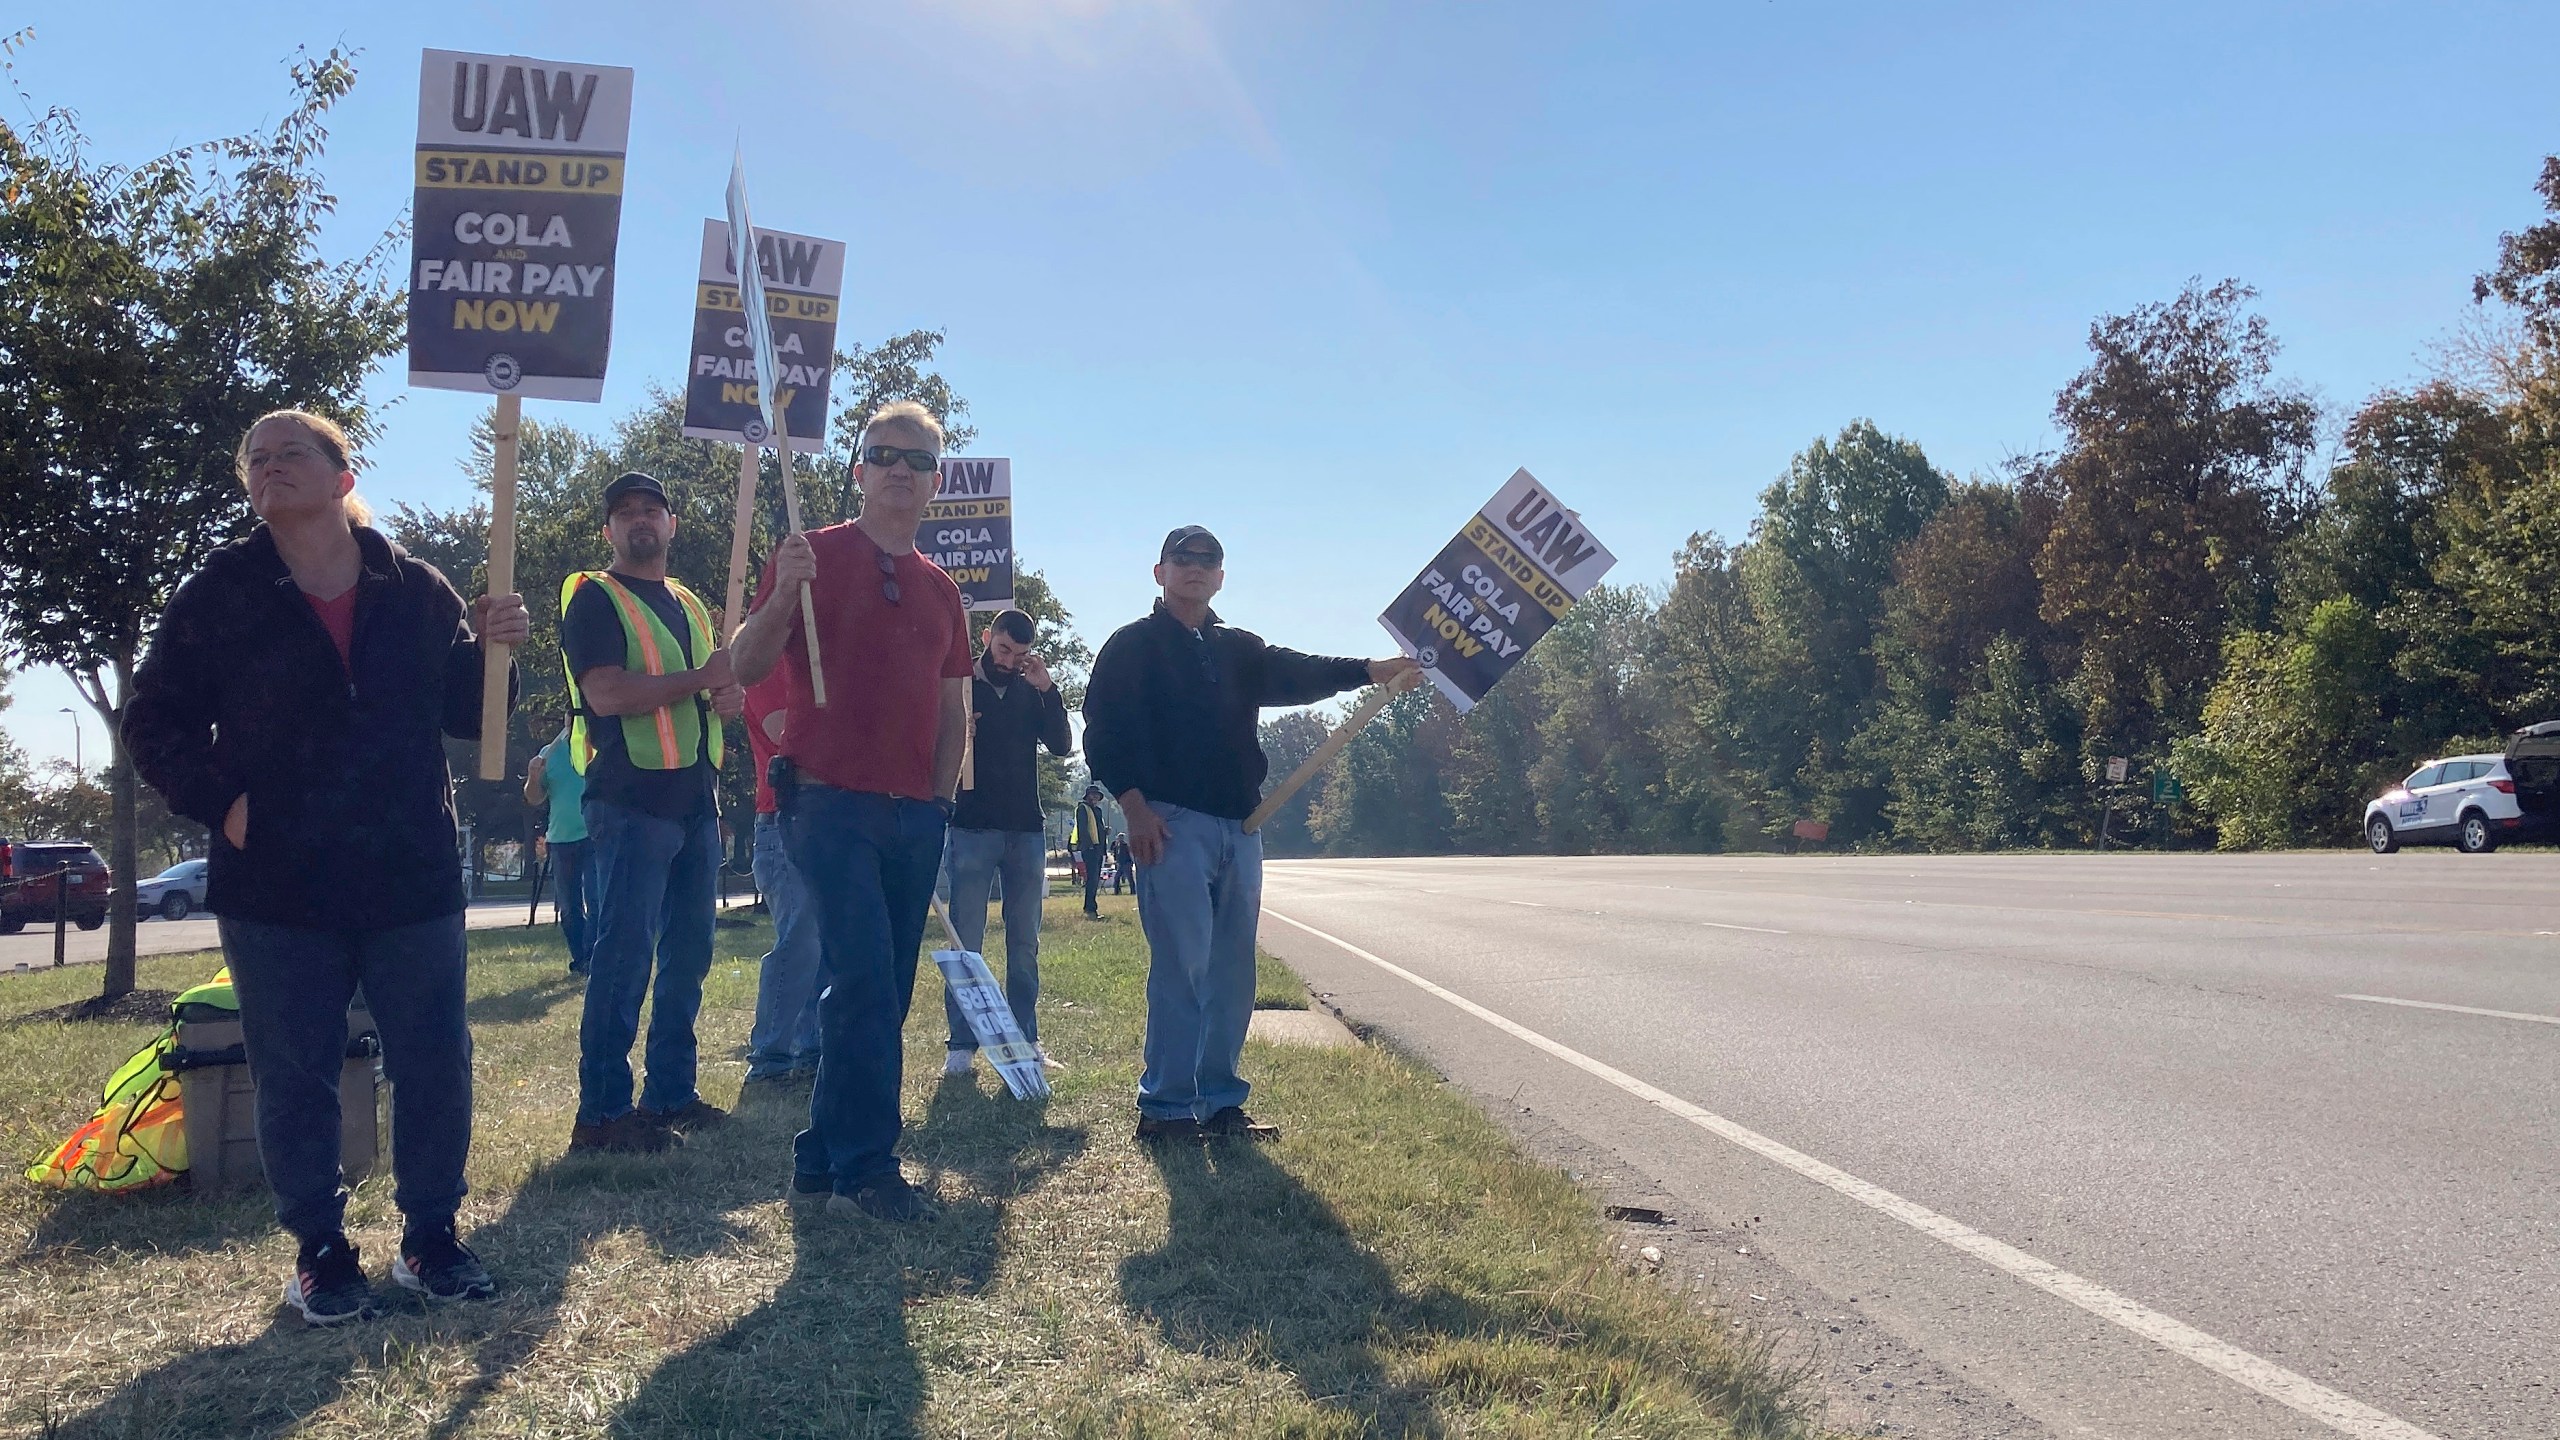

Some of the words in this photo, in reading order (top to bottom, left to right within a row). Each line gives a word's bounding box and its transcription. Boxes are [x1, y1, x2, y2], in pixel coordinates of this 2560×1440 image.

[452, 61, 598, 142] UAW
[426, 157, 547, 185] STAND
[561, 162, 609, 188] UP
[454, 211, 573, 248] COLA
[495, 249, 527, 261] AND
[726, 230, 823, 287] AW
[417, 259, 513, 294] FAIR
[522, 263, 605, 298] PAY
[453, 299, 560, 333] NOW
[798, 299, 830, 318] UP
[984, 502, 1006, 515] UP
[936, 527, 992, 545] COLA
[1506, 488, 1597, 576] UAW
[971, 547, 1008, 566] PAY
[1470, 524, 1534, 583] STAND
[1534, 581, 1564, 609] UP
[1421, 568, 1475, 622] FAIR
[1469, 613, 1522, 659] PAY
[1461, 564, 1521, 626] COLA
[1422, 602, 1484, 658] NOW
[976, 1010, 1018, 1036] END
